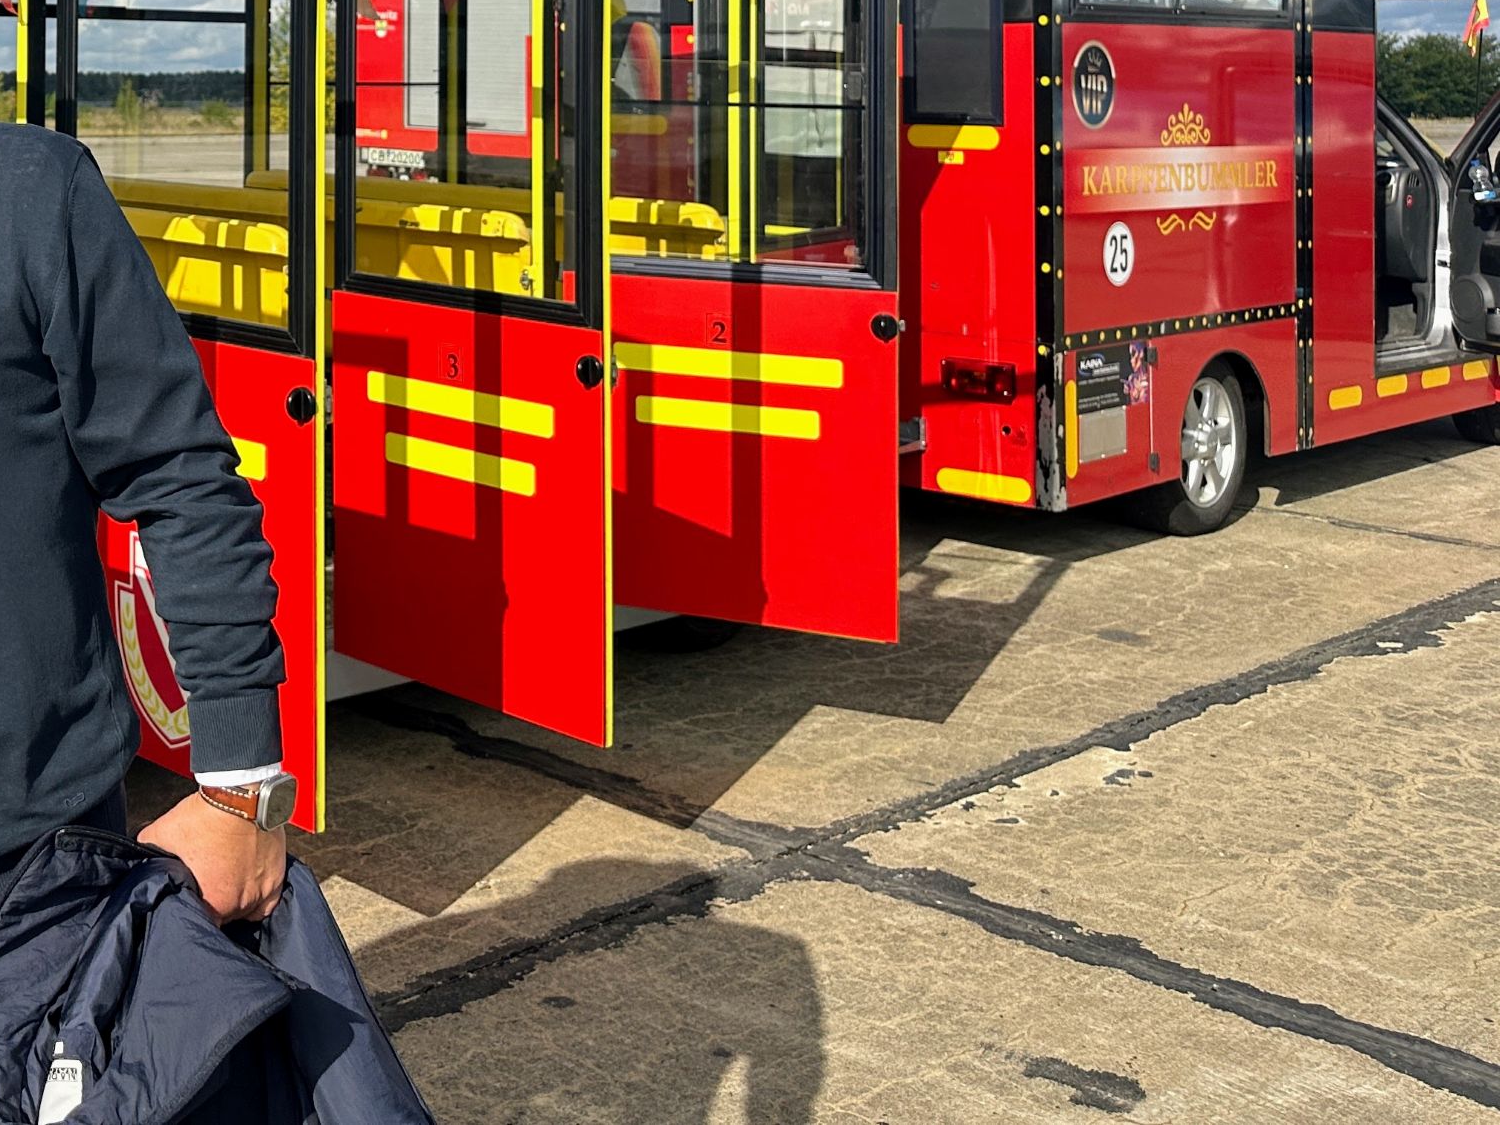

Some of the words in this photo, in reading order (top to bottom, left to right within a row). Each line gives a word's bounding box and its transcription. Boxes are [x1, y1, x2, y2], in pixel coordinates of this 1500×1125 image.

[1081, 74, 1107, 115] VIP
[1082, 160, 1278, 196] KARPFENBUMMLER
[1110, 234, 1128, 273] 25
[712, 321, 727, 343] 2
[447, 354, 458, 379] 3
